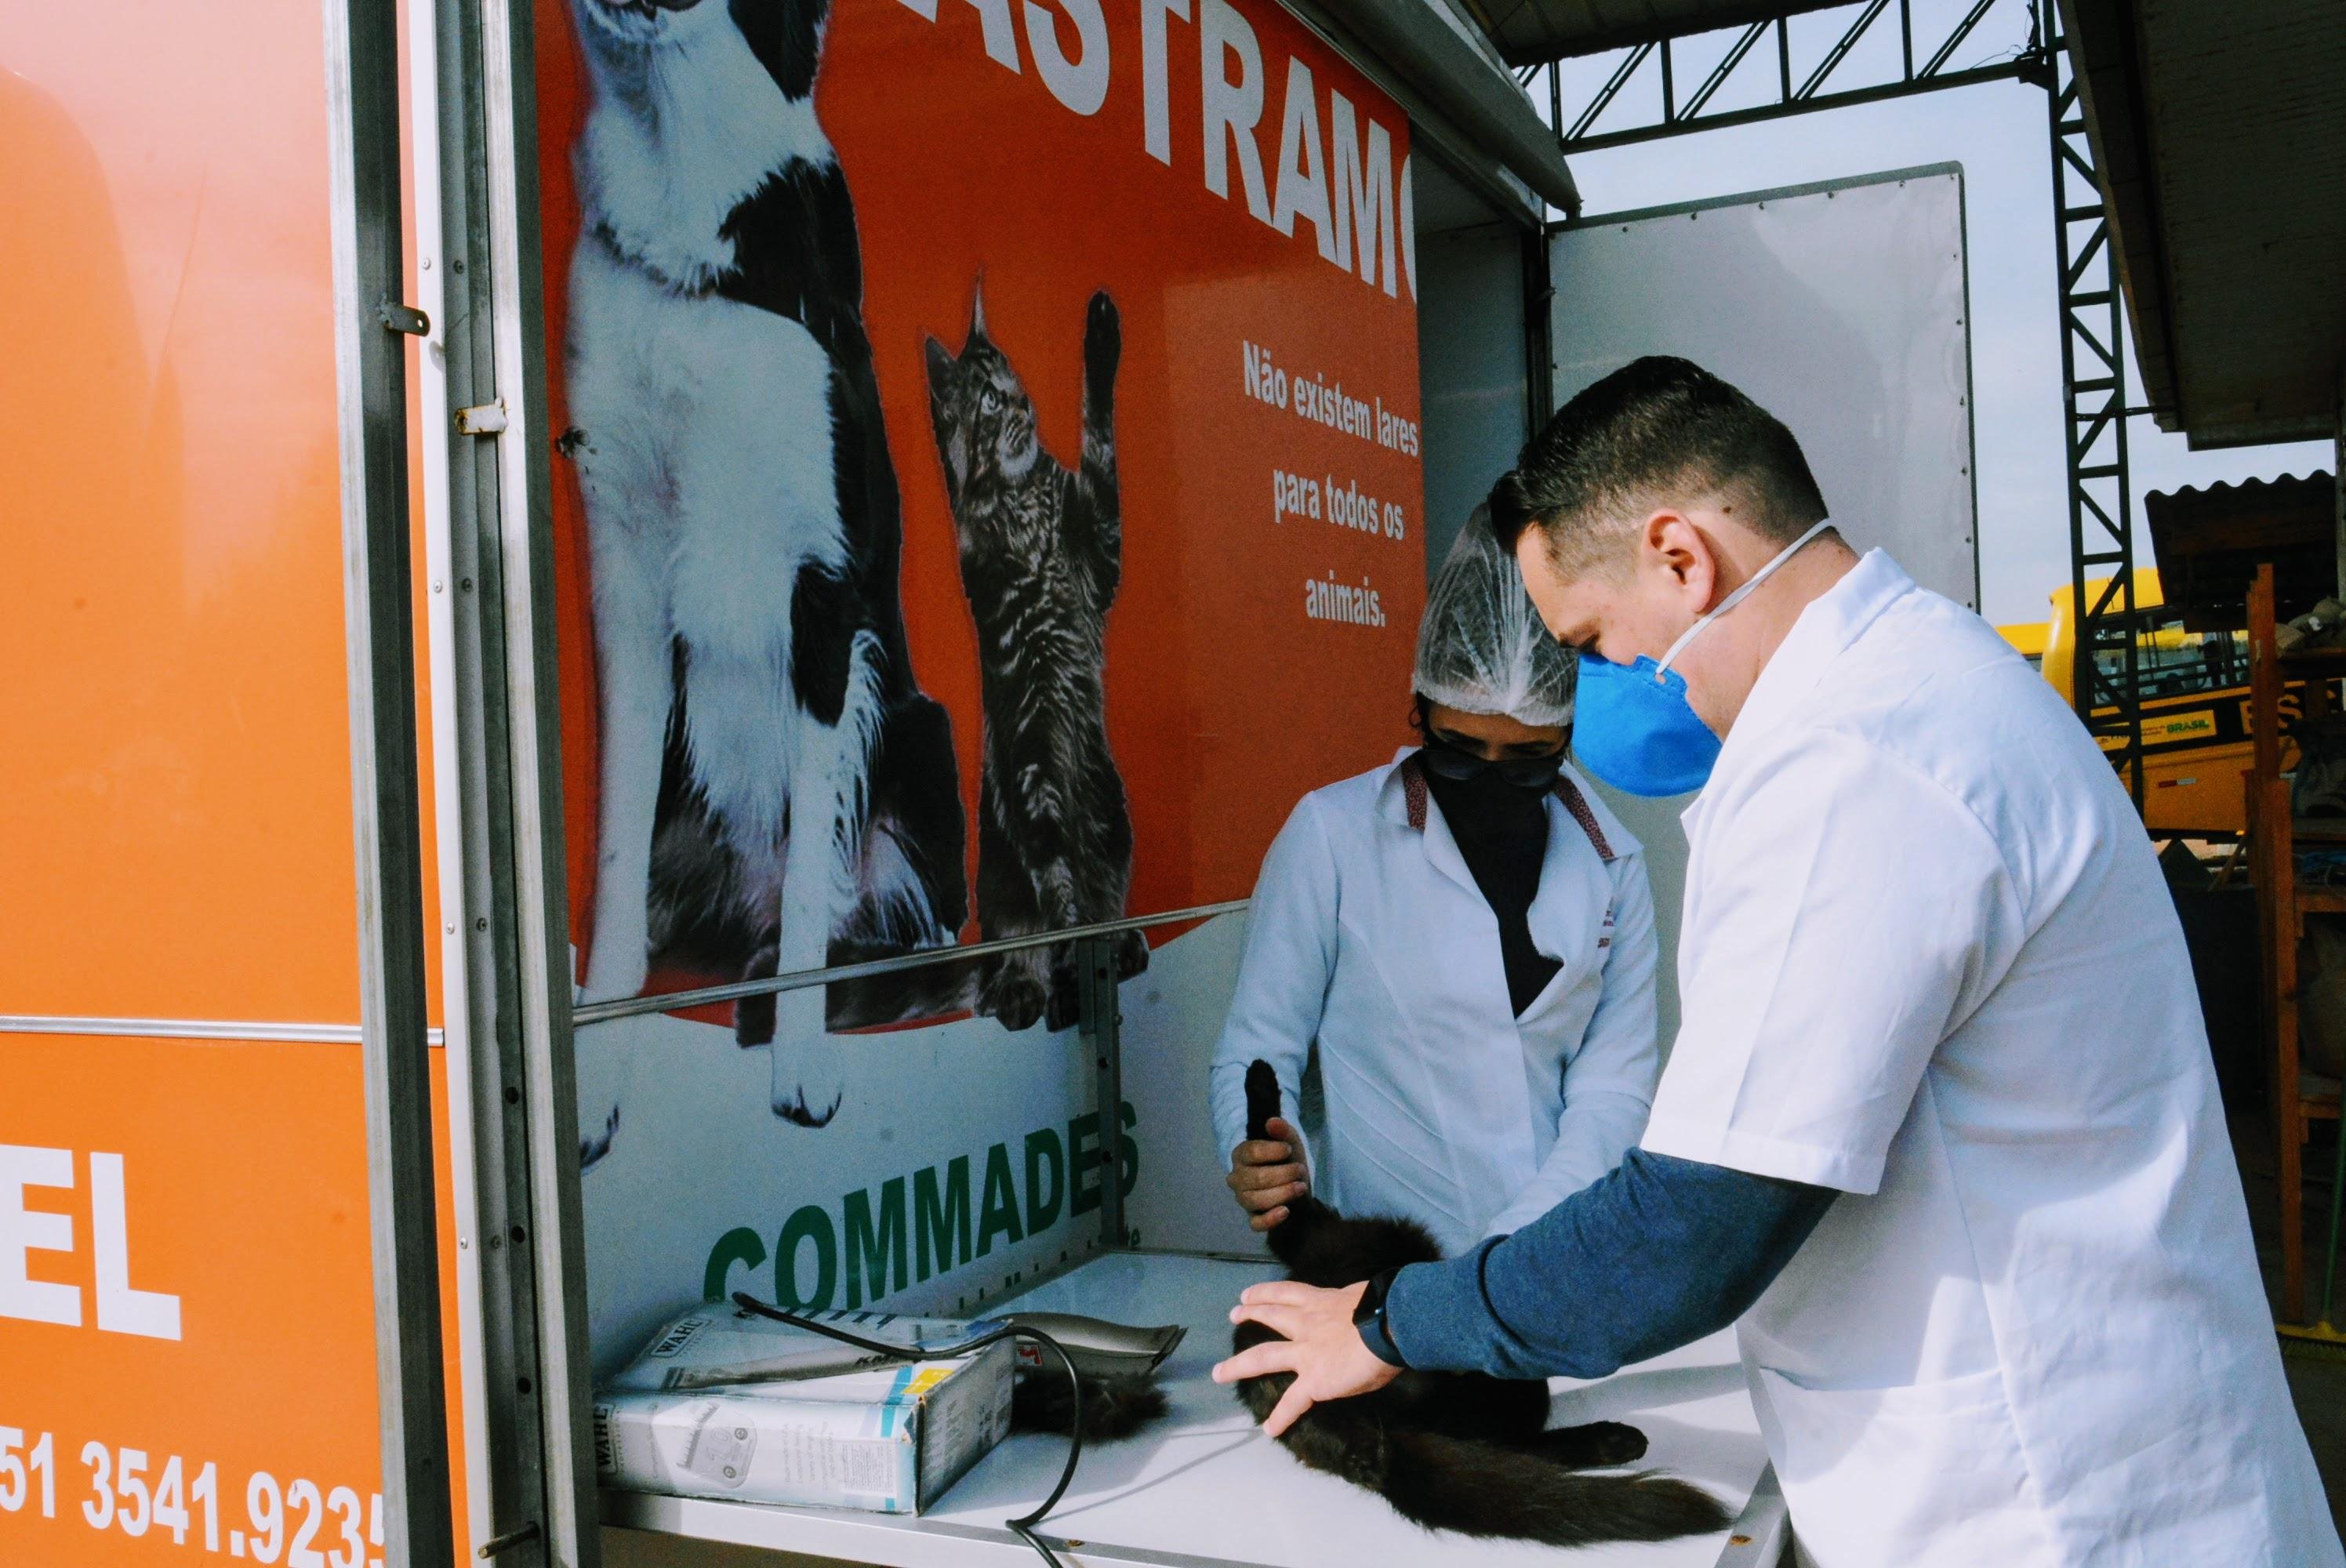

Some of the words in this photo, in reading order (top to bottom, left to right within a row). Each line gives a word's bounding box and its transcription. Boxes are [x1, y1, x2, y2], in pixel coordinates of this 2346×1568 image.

[1243, 339, 1287, 409] Não
[1294, 372, 1371, 440] existem
[1375, 396, 1418, 457] lares
[1273, 469, 1320, 523] para
[1325, 473, 1378, 534] todos
[1384, 501, 1404, 540] os
[1306, 569, 1385, 627] animais.
[2166, 719, 2210, 733] BRASIL
[655, 1321, 703, 1353] WAHL
[594, 1407, 612, 1468] WAHL
